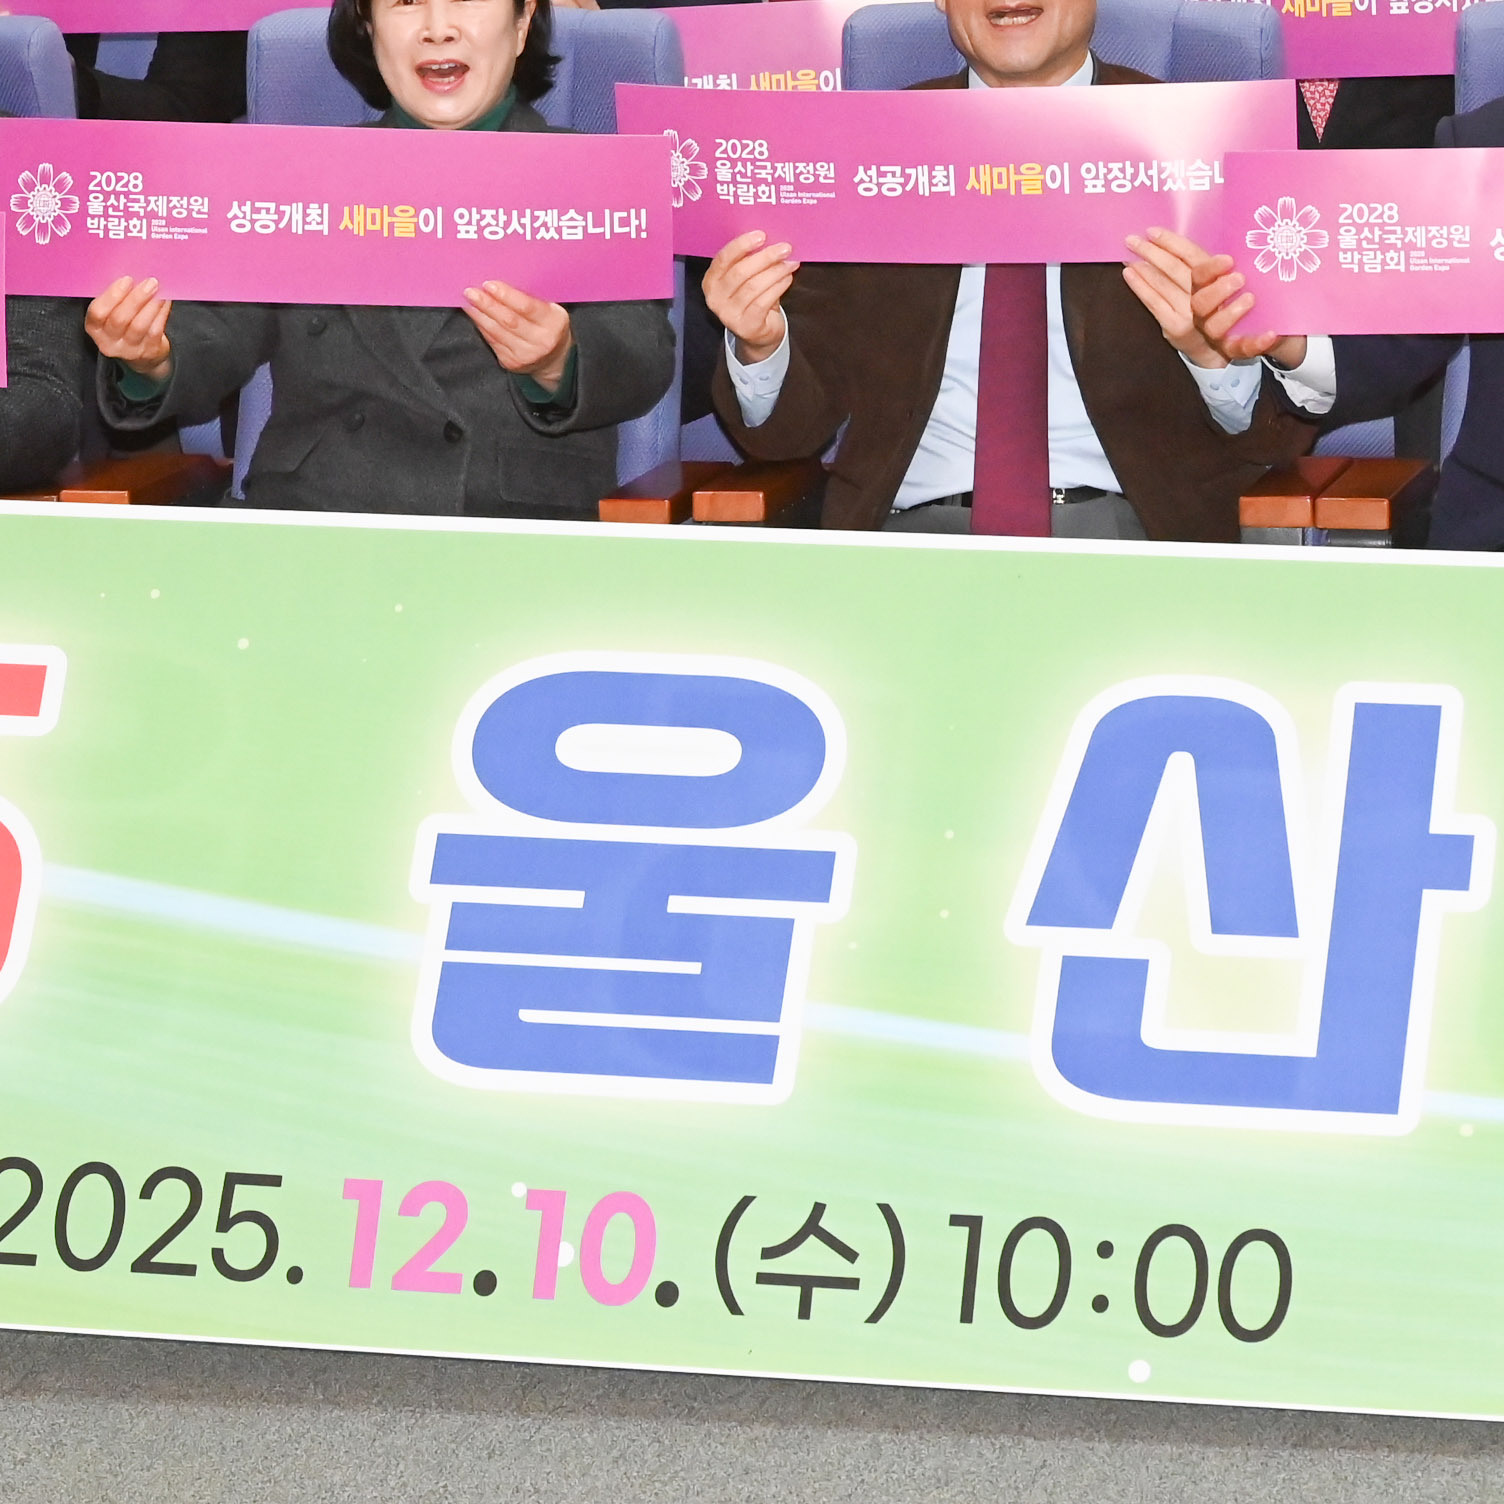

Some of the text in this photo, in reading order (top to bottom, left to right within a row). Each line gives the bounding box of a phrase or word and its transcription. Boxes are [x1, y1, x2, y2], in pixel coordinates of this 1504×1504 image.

[714, 138, 769, 160] 2028
[88, 171, 143, 193] 2028
[714, 160, 836, 184] 울산국제정원
[853, 165, 956, 197] 성공개최
[965, 162, 1070, 196] 새마을이
[86, 192, 209, 219] 울산국제정원
[716, 184, 777, 206] 박람회
[226, 200, 647, 241] 성공개최 새마을이 앞장서겠습니다!
[1339, 202, 1399, 224] 2028
[86, 216, 147, 240] 박람회
[1338, 225, 1470, 249] 울산국제정원
[1339, 250, 1405, 273] 박람회
[948, 1214, 1293, 1343] 10:00
